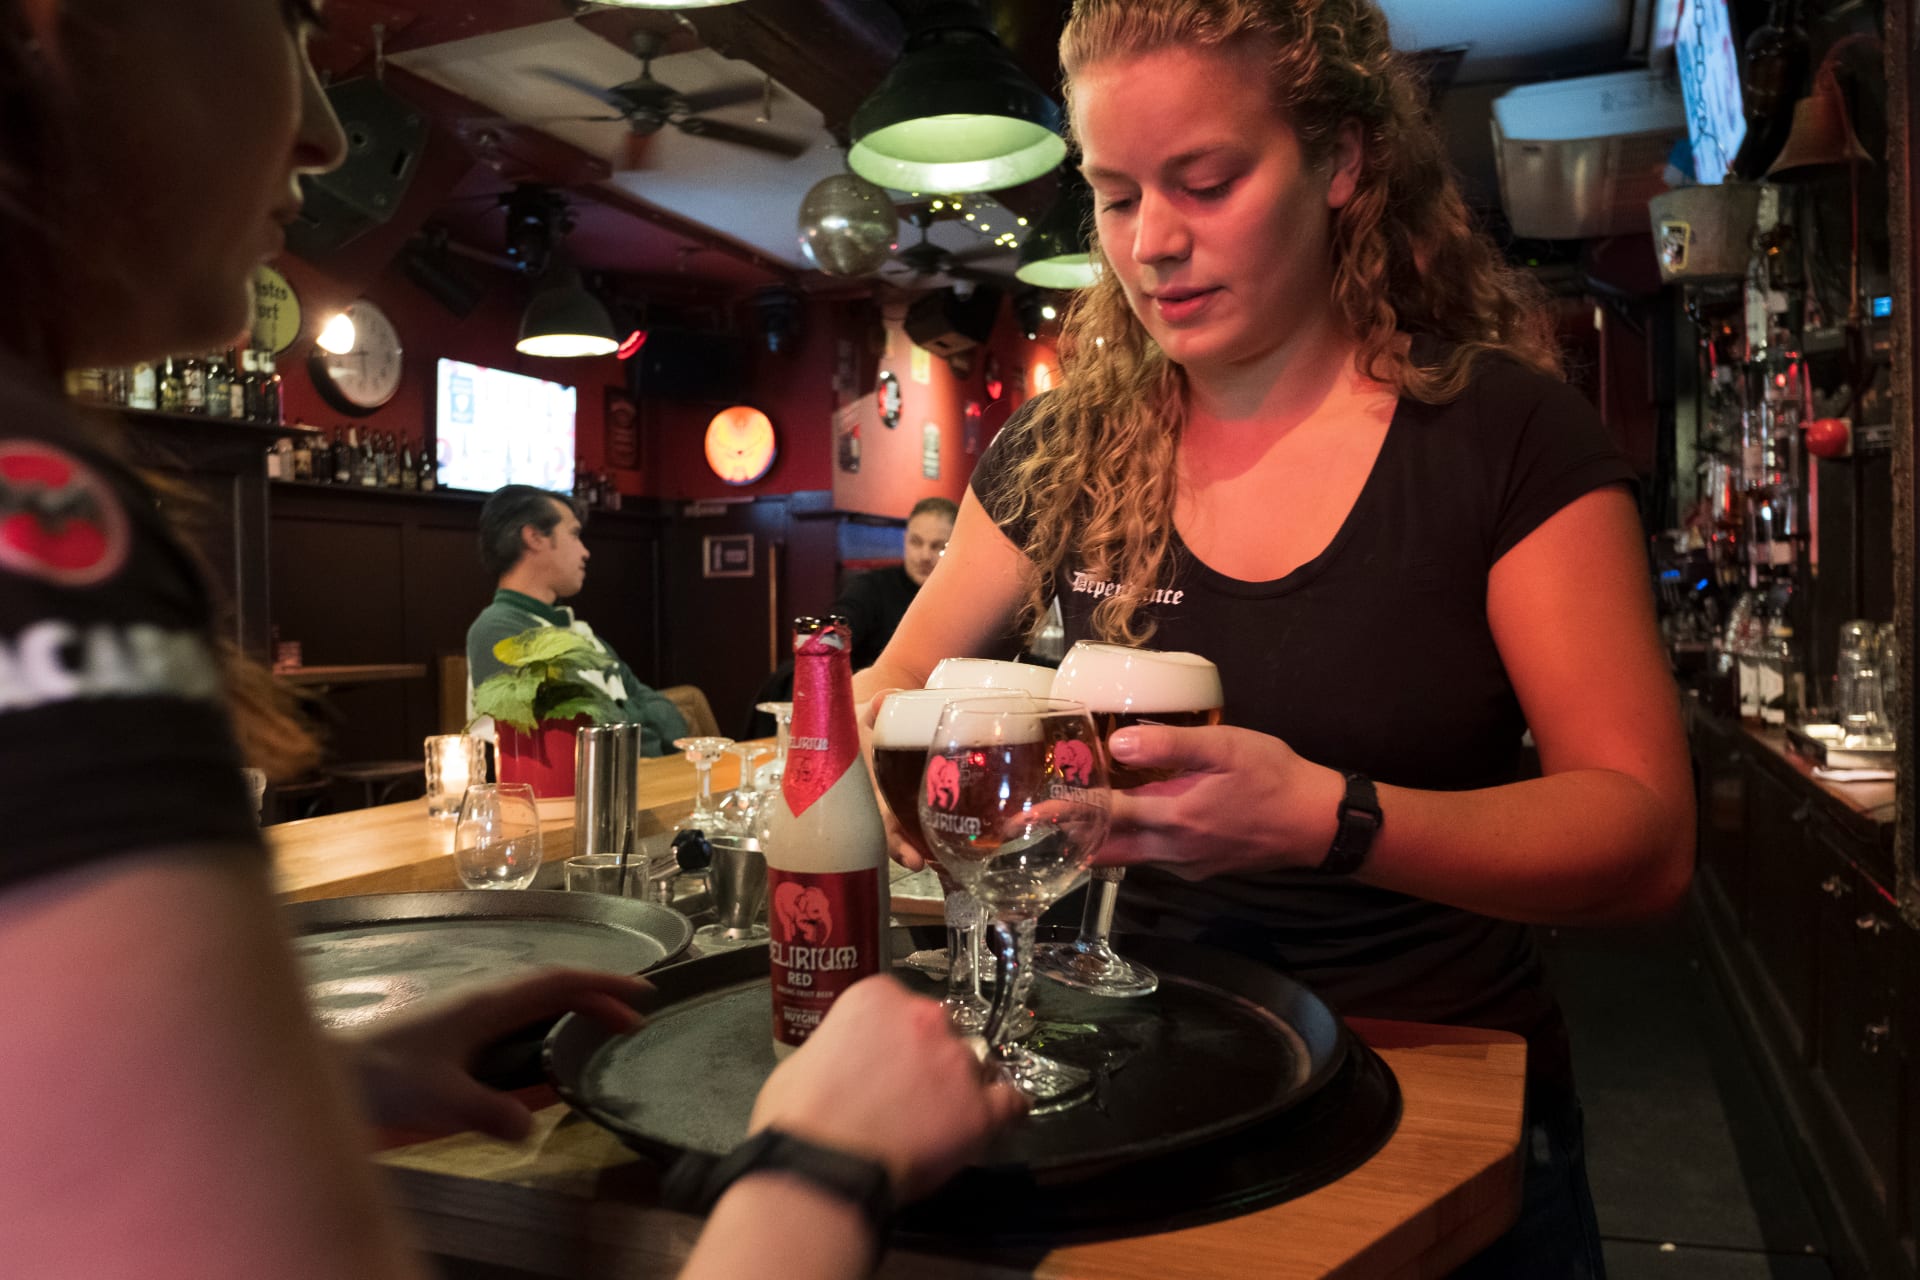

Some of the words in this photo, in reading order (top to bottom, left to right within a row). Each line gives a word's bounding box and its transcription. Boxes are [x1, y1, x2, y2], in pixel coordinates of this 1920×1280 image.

[1072, 571, 1185, 605] Depence
[788, 735, 829, 752] ELIRIUM
[768, 940, 859, 972] ELIRIUM
[787, 971, 813, 987] RED
